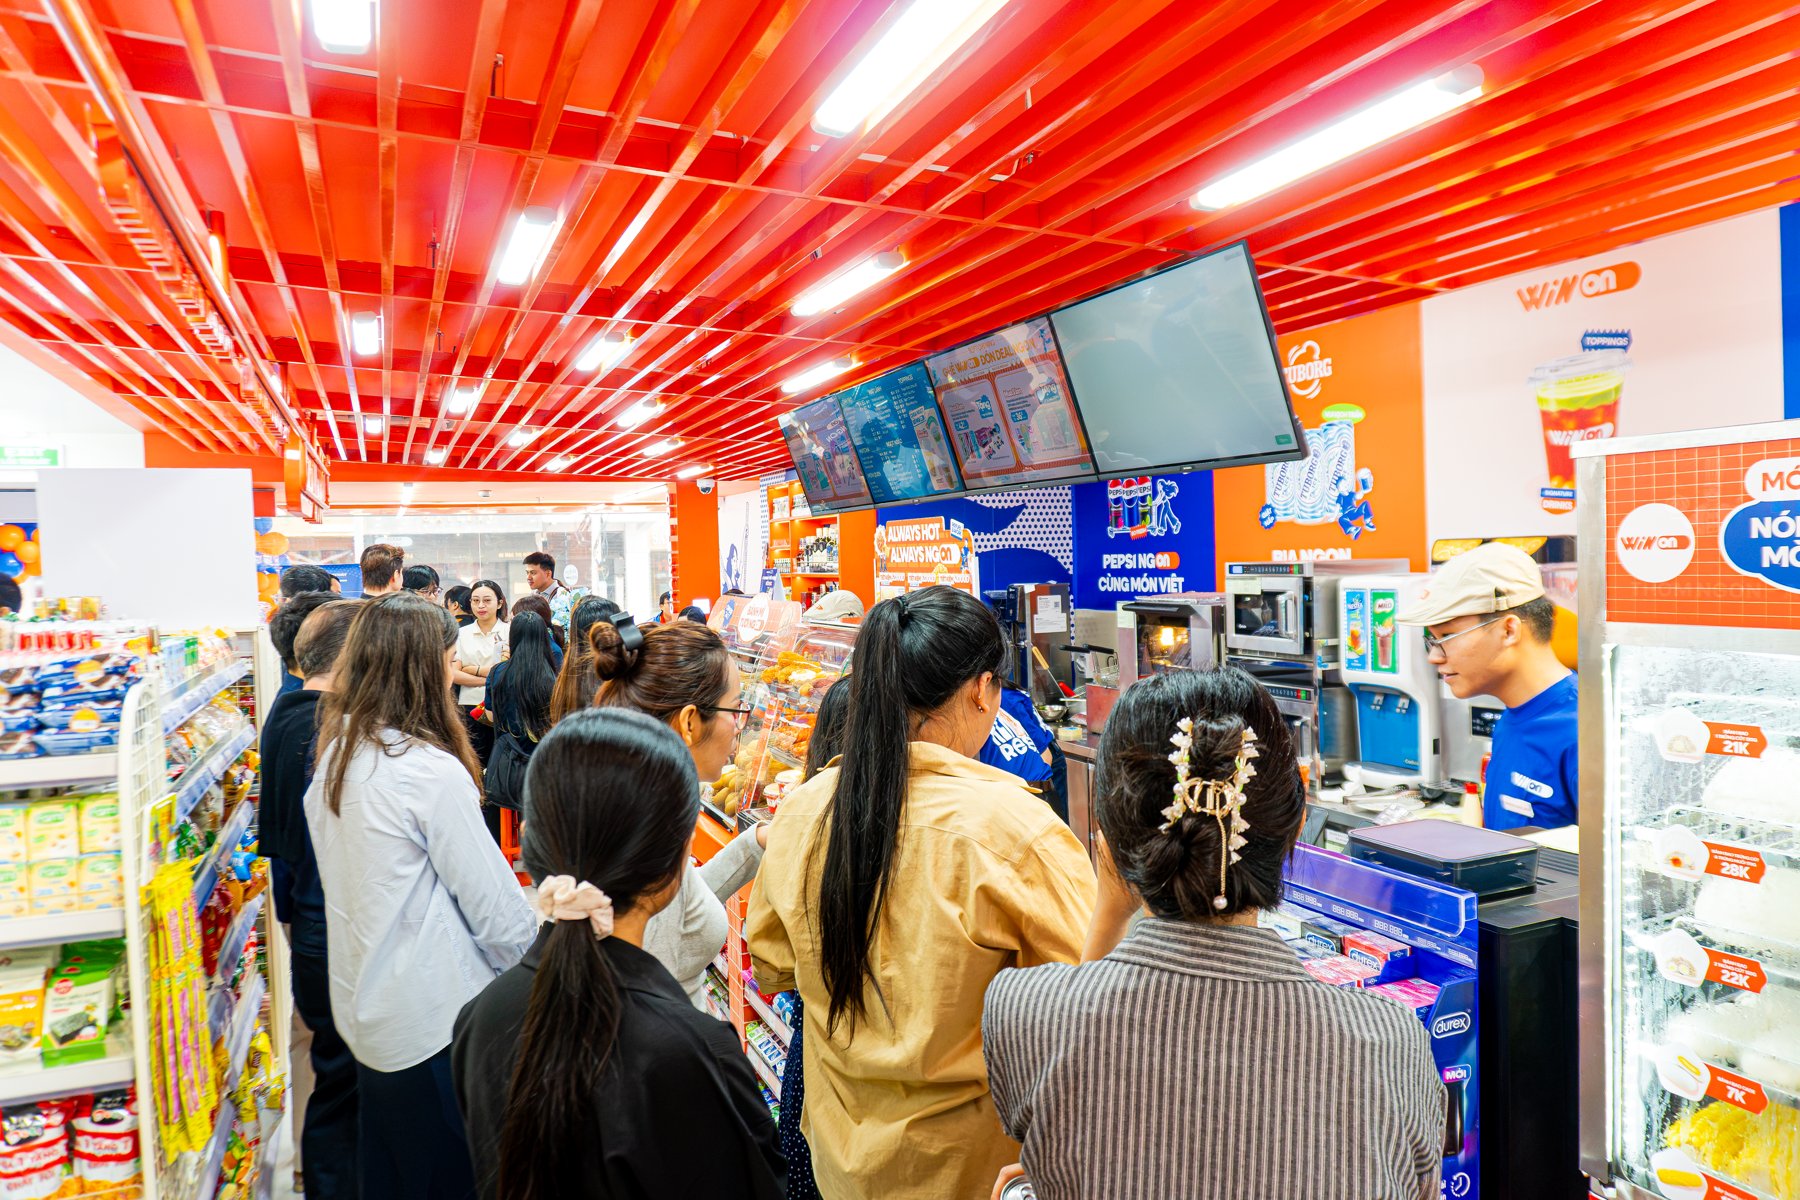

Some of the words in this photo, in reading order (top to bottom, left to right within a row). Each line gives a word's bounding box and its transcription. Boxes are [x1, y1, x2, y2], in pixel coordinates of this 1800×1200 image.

[1585, 335, 1629, 347] TOPPINGS
[996, 346, 1012, 360] DEAL
[1283, 358, 1332, 384] TUBORG
[1273, 461, 1289, 498] TUBOR
[1300, 458, 1318, 500] TUBORG
[1542, 500, 1573, 511] DRINKS
[888, 524, 921, 542] ALWAYS
[922, 523, 940, 540] HOT
[1749, 509, 1800, 539] NÓ
[890, 546, 926, 563] ALWAYS
[1103, 553, 1136, 569] PEPSI
[1098, 572, 1130, 592] CÙNG
[1131, 573, 1157, 592] MÓN
[1722, 740, 1750, 755] 21K
[1720, 862, 1750, 879] 28K
[1332, 905, 1359, 921] 888.888
[1374, 920, 1403, 937] 888.888
[1308, 934, 1334, 951] durex
[1351, 952, 1380, 971] durex
[1721, 969, 1750, 988] 22K
[1436, 1016, 1468, 1034] durex
[1726, 1085, 1746, 1105] 7K
